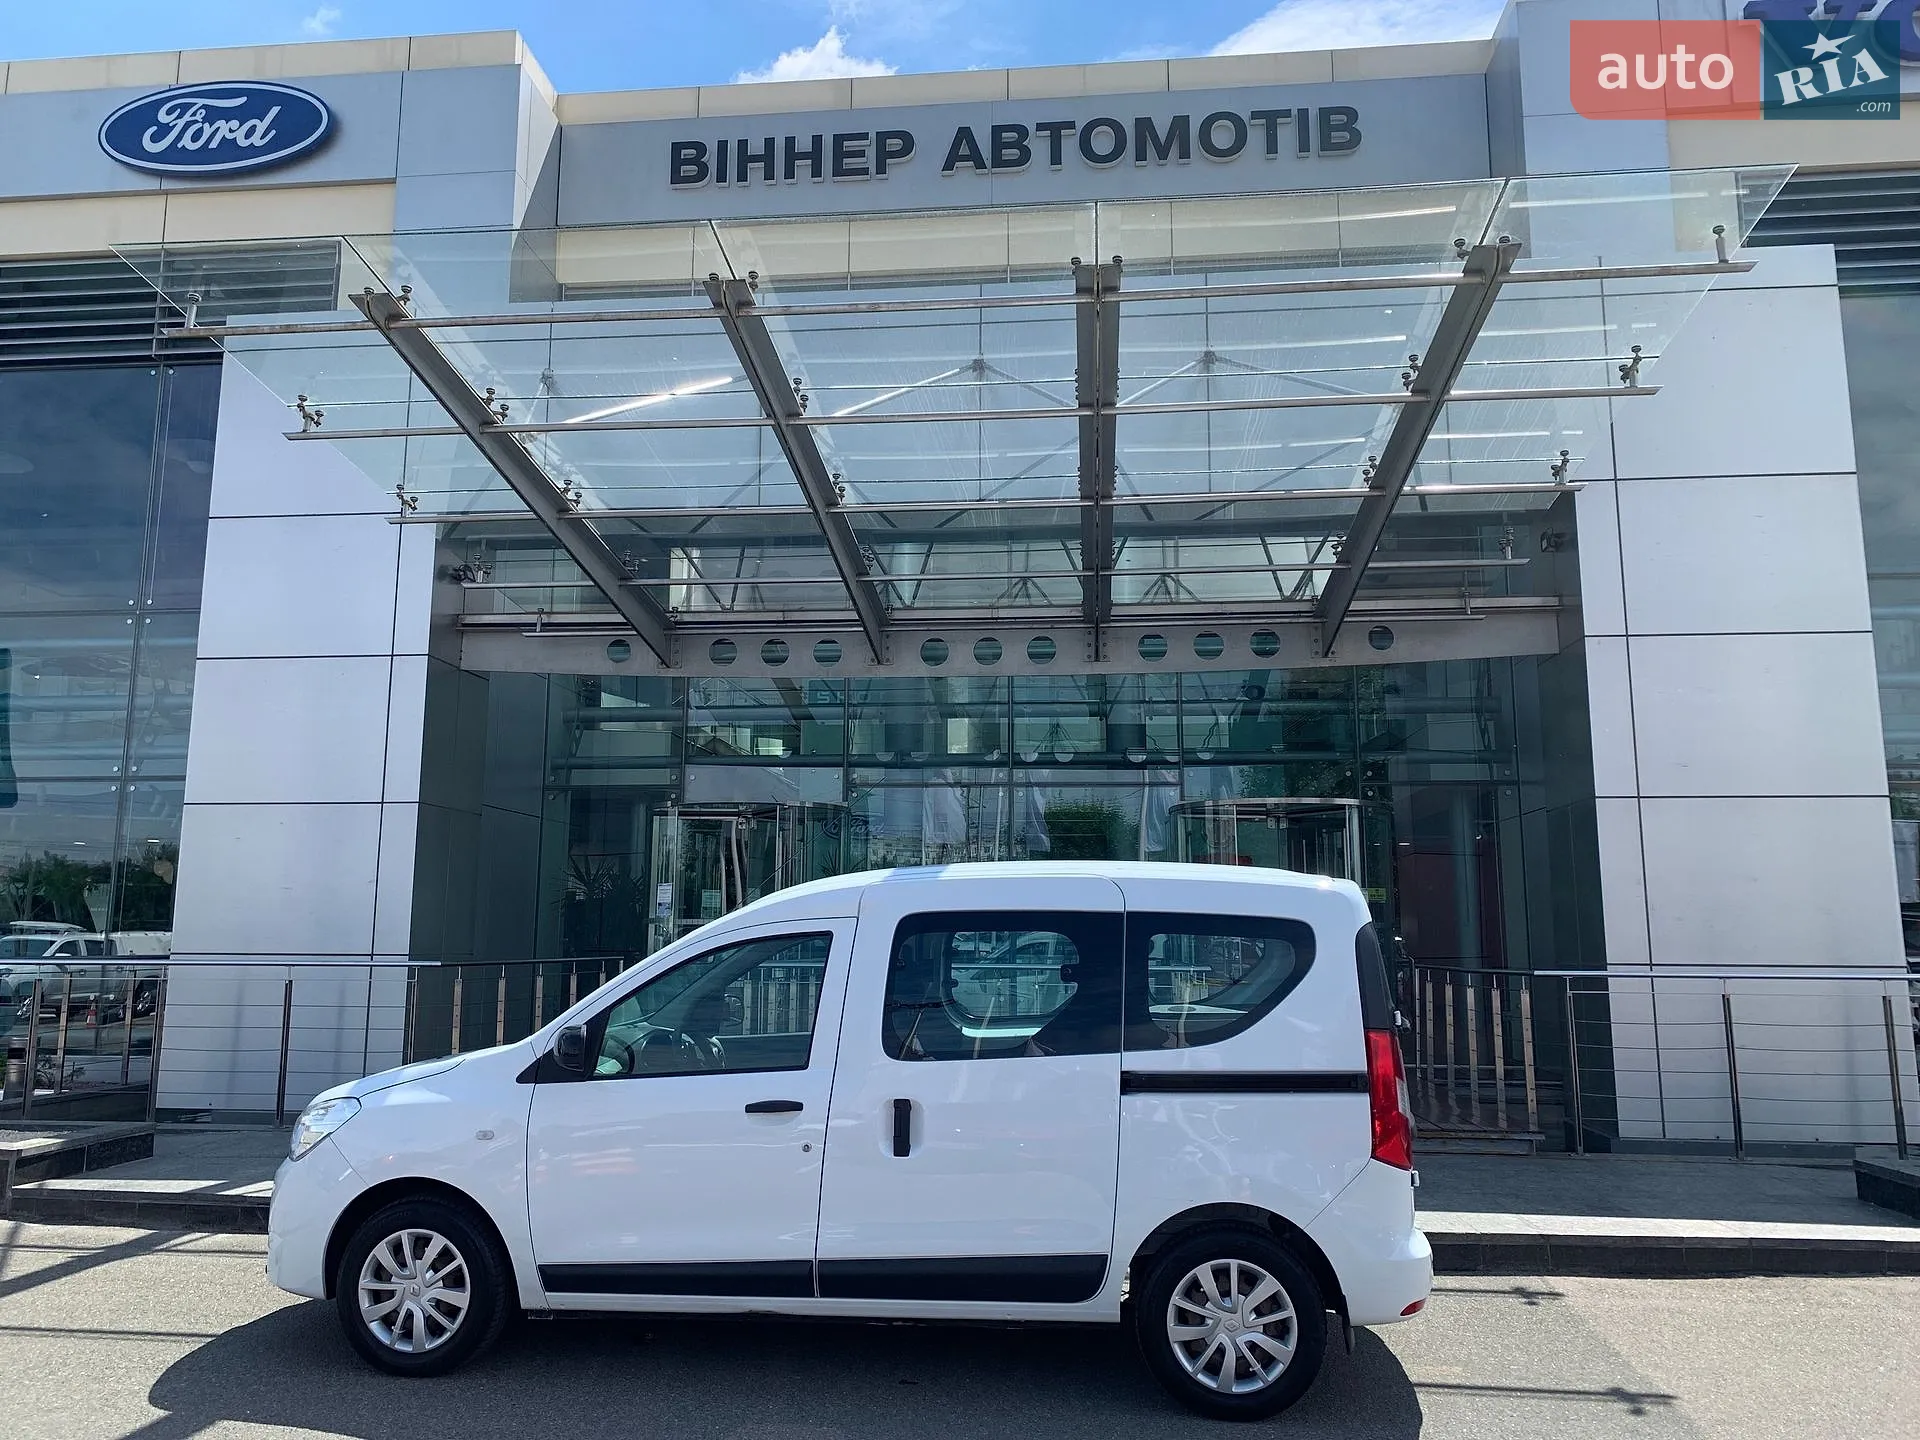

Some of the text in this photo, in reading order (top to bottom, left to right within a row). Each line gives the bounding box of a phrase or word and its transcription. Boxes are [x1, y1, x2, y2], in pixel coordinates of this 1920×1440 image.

[142, 97, 281, 153] Ford
[669, 105, 1363, 189] ВІННЕР АВТОМОТІВ
